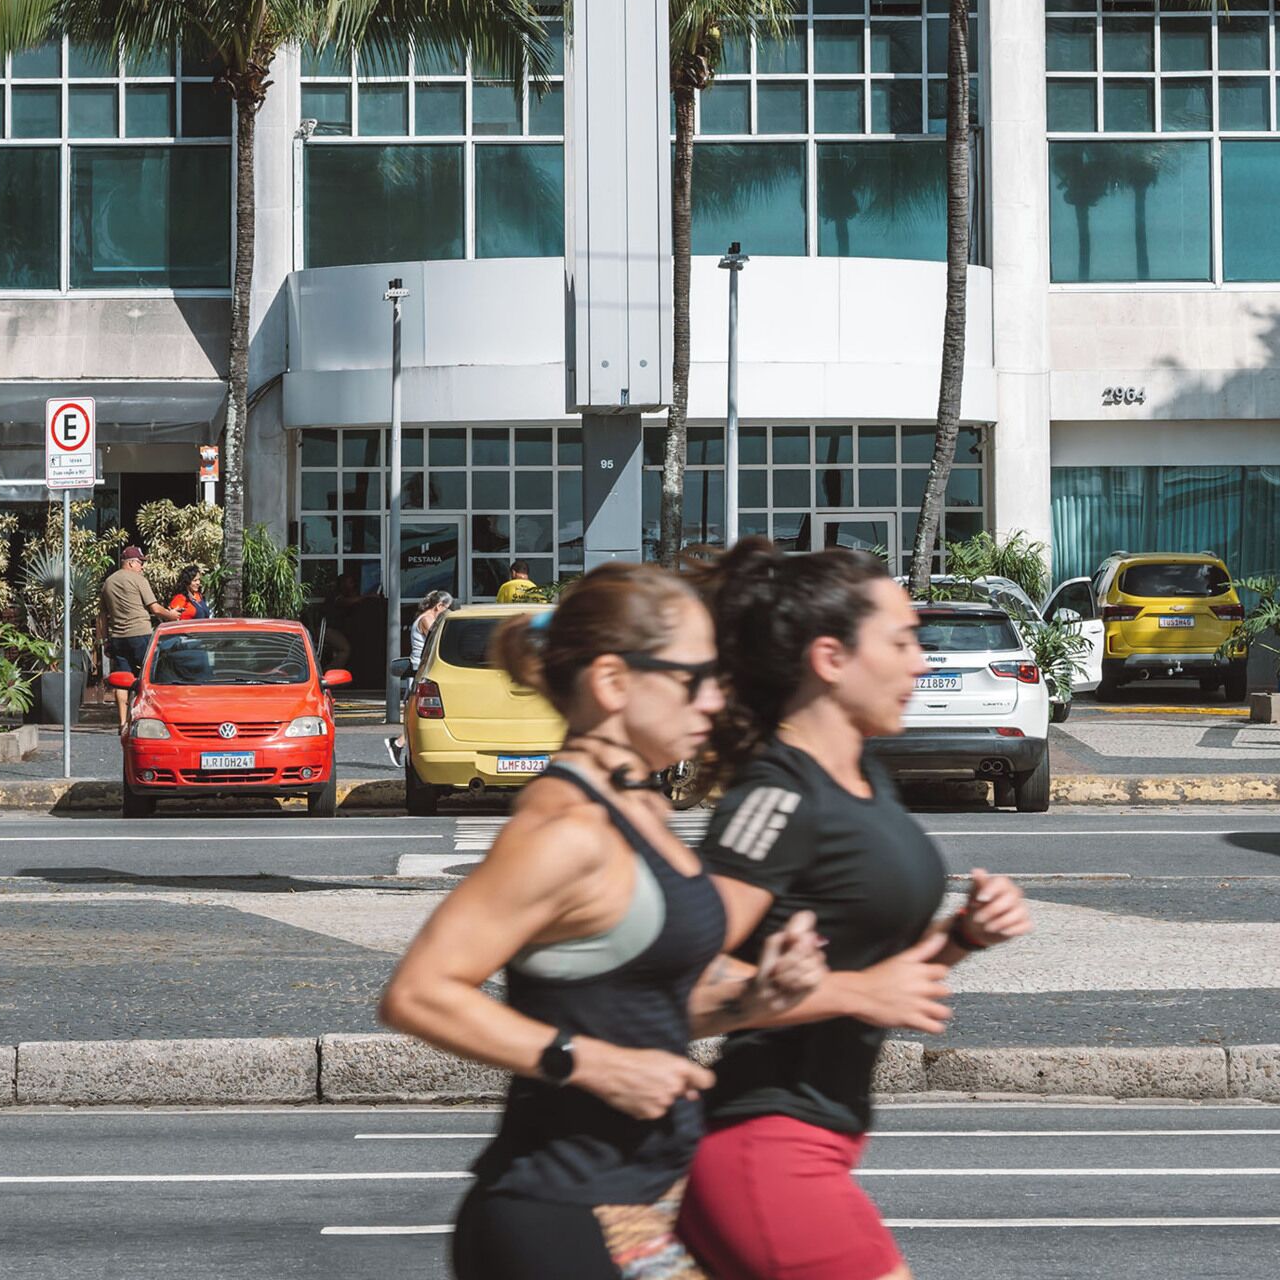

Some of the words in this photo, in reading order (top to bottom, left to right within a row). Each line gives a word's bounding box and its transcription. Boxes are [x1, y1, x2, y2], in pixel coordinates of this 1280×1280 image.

[1102, 386, 1146, 405] 2964
[64, 414, 77, 440] E
[600, 459, 614, 469] 95
